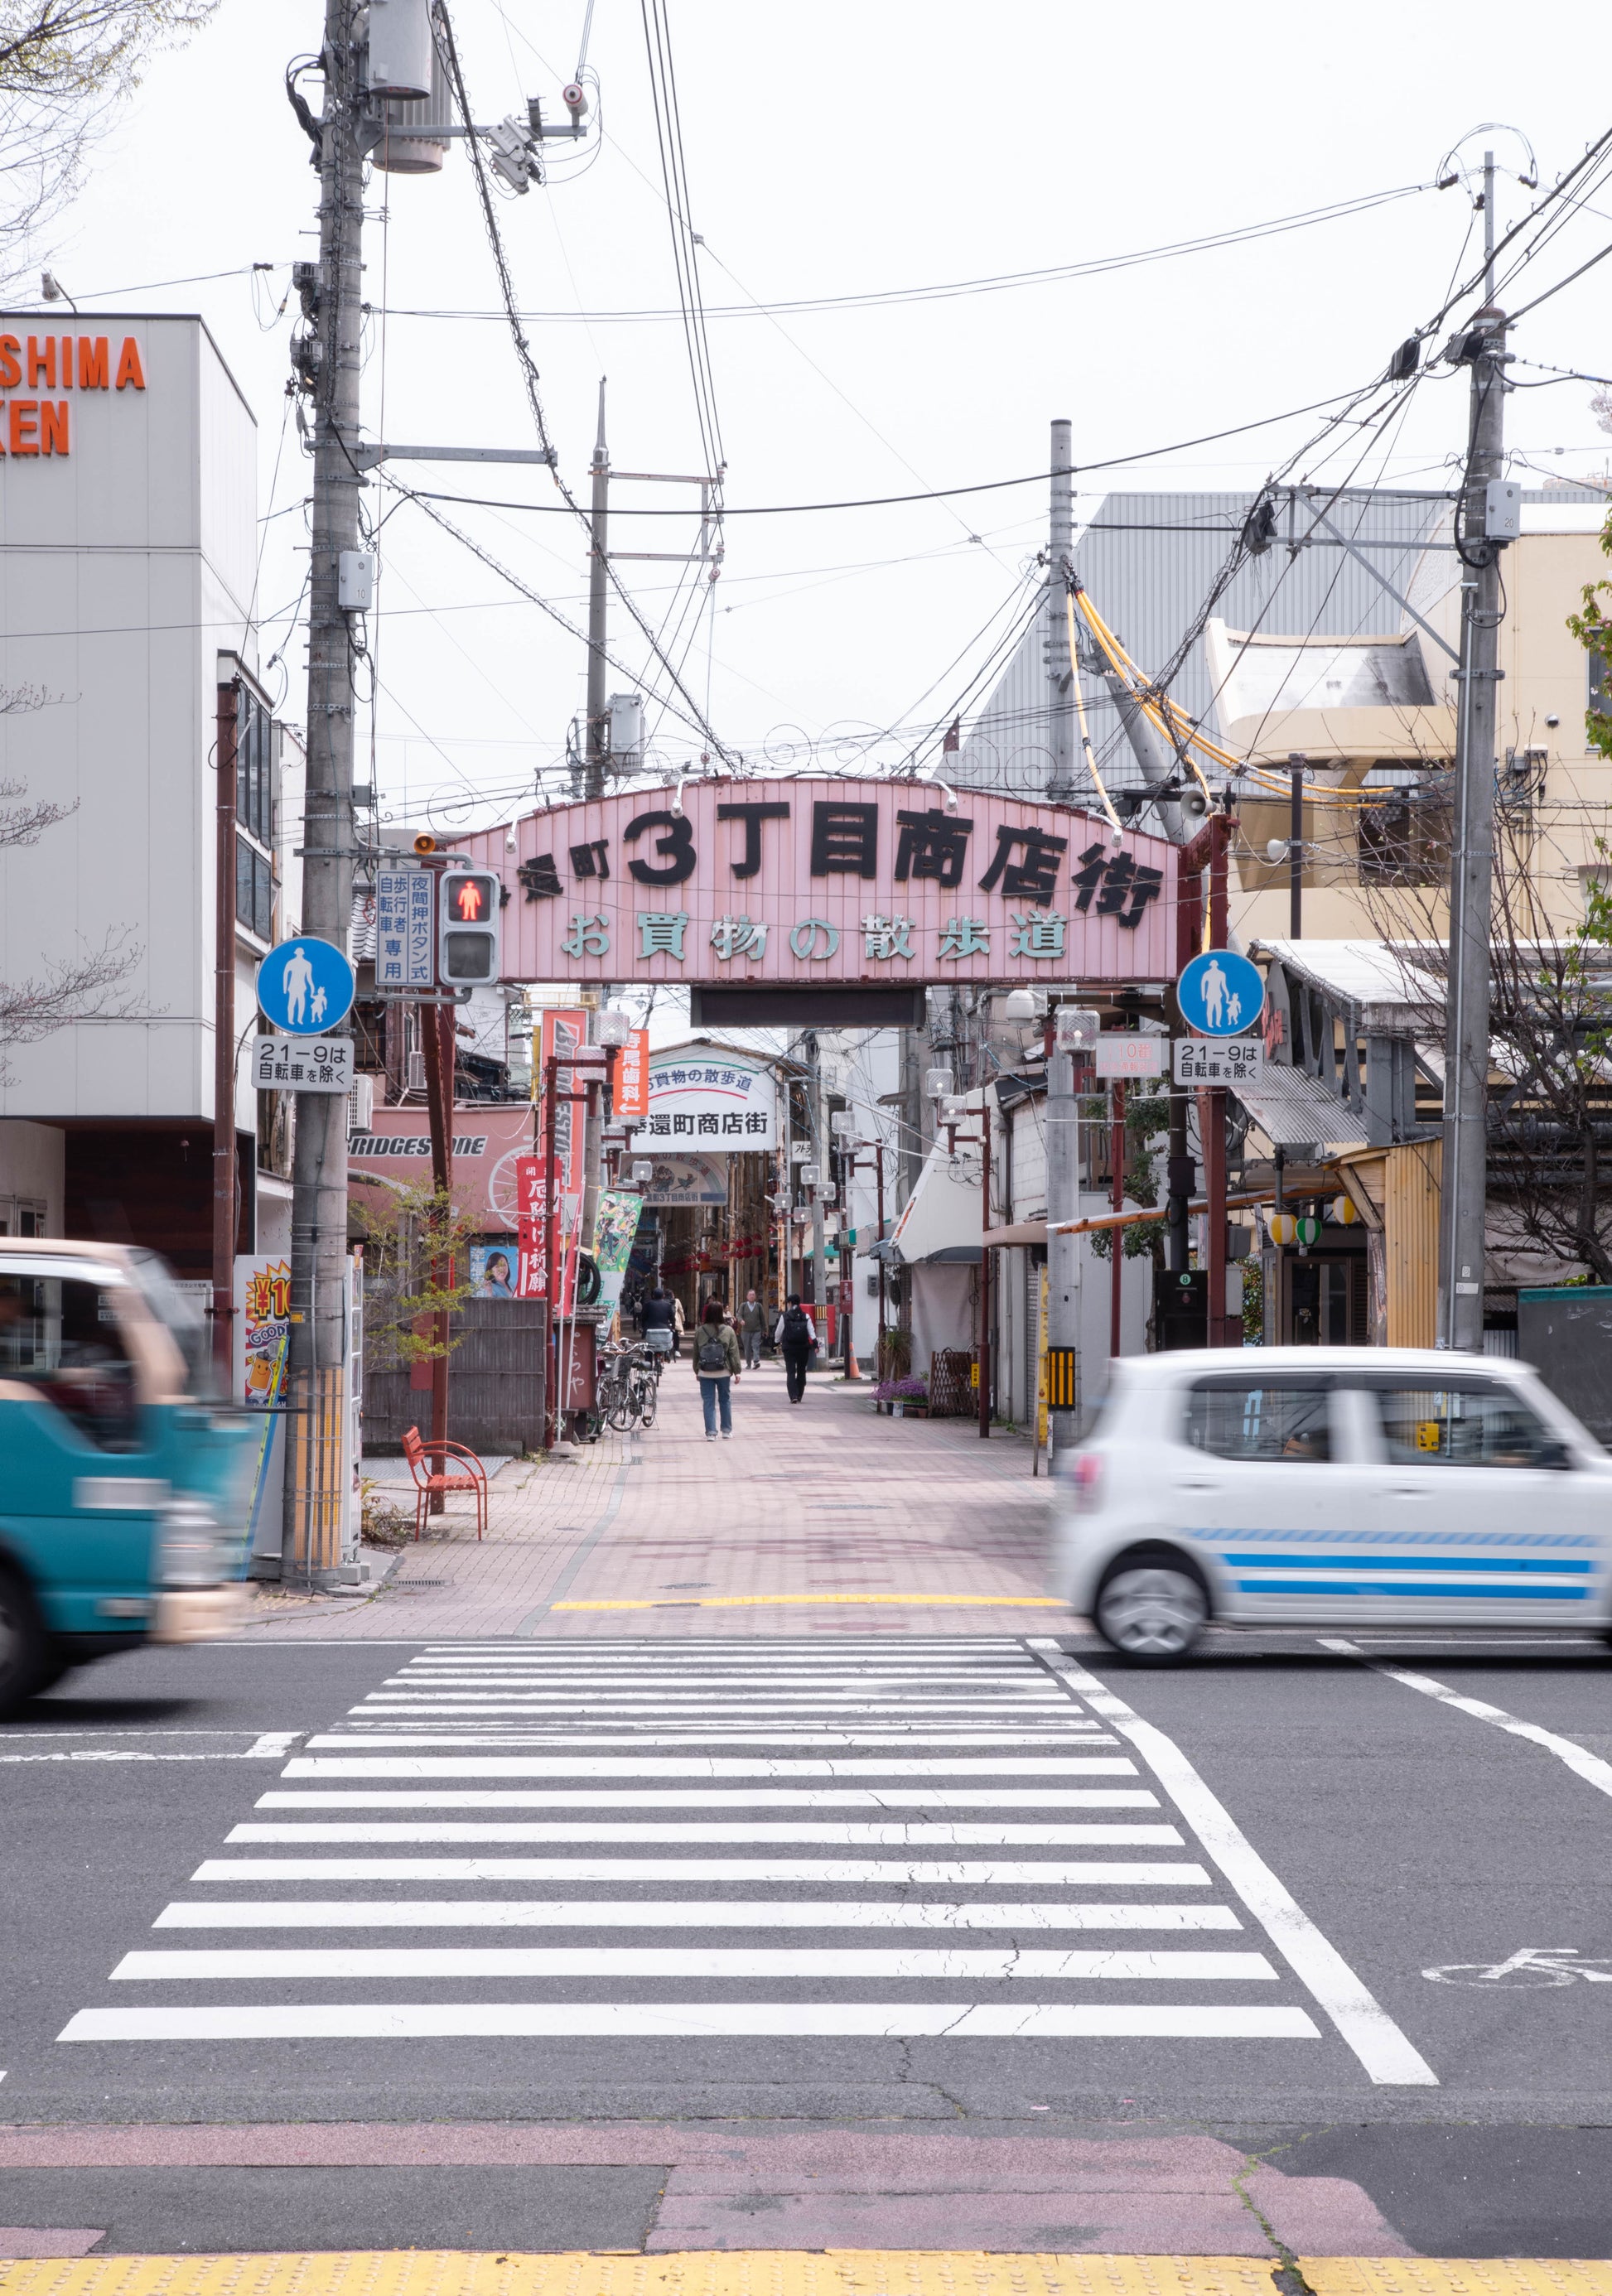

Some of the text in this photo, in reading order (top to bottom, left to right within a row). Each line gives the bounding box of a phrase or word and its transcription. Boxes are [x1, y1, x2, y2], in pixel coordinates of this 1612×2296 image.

[0, 334, 146, 389] SHIMA
[0, 400, 69, 456] EN
[1504, 517, 1514, 528] 20
[357, 589, 365, 599] 10
[500, 801, 1163, 929] 還町3丁目商店街
[379, 876, 393, 933] 自転車
[393, 876, 407, 933] 歩行者
[412, 876, 429, 980] 夜間押ボタン式
[384, 938, 402, 979] 専用
[561, 910, 1068, 961] お買物の散歩道
[259, 1062, 345, 1084] 自転車を除く
[621, 1032, 641, 1102] 寺尾歯科
[1108, 1043, 1152, 1059] 110番
[1181, 1062, 1257, 1078] 自転車を除く
